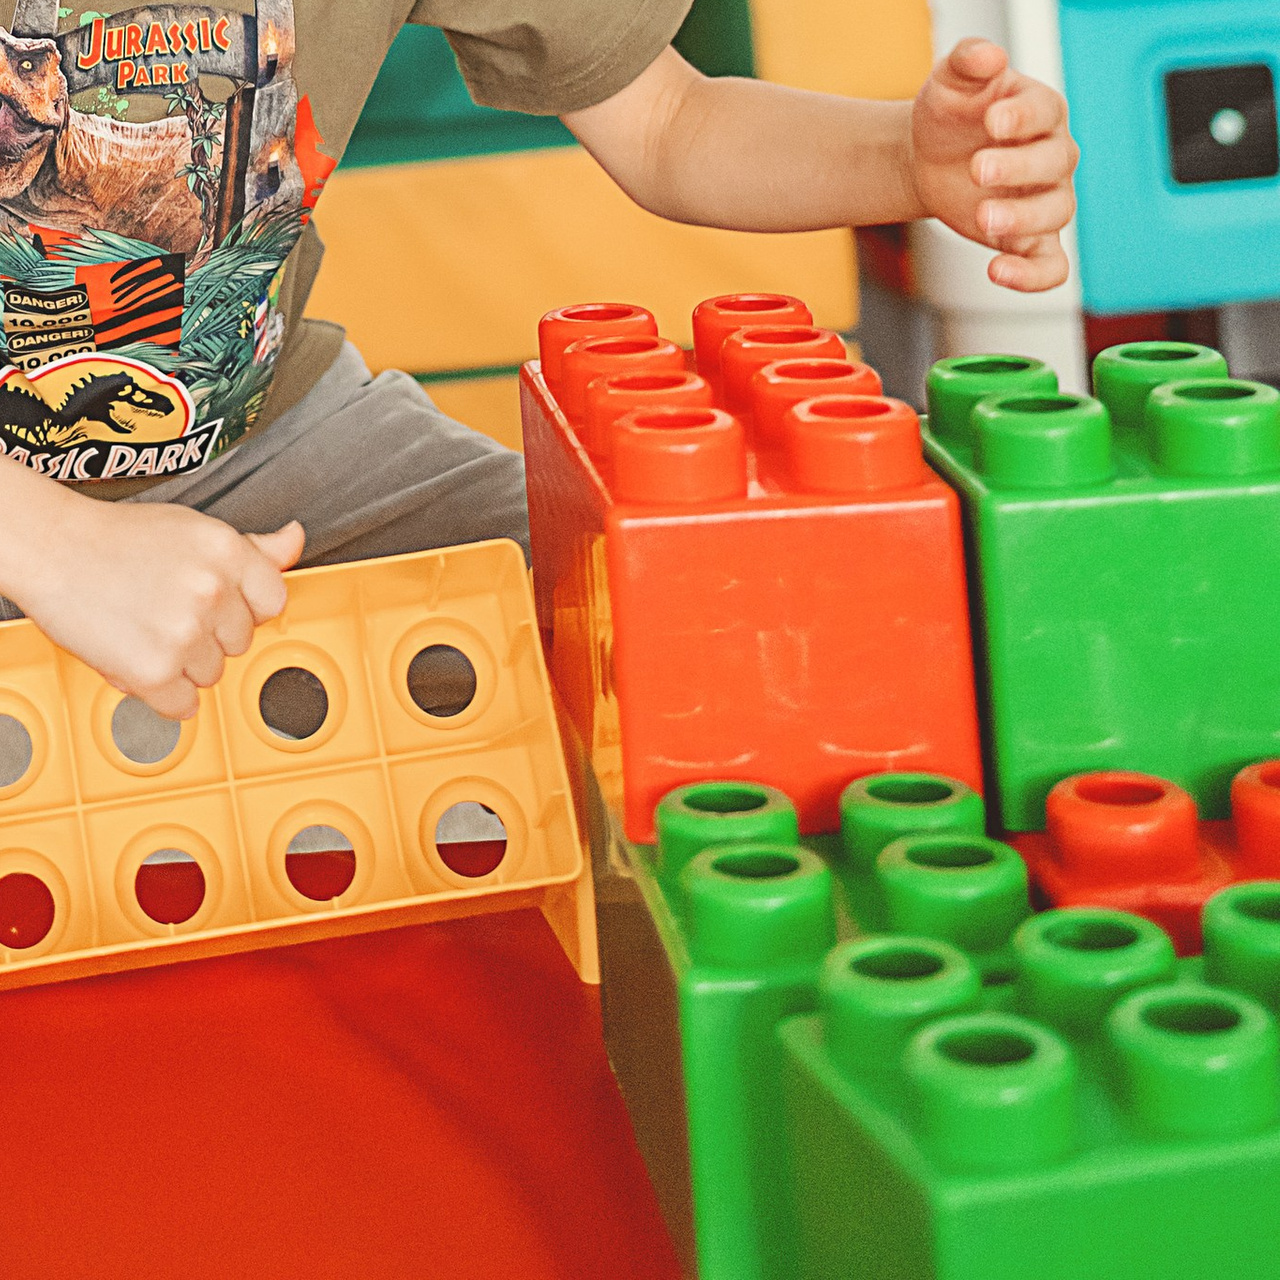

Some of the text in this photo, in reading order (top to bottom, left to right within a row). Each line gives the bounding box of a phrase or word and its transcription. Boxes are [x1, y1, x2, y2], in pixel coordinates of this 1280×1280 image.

[78, 16, 232, 70] JURASSIC
[117, 59, 189, 89] PARK
[9, 294, 83, 309] DANGER!
[12, 329, 89, 348] DANGER!
[100, 433, 210, 479] PARK
